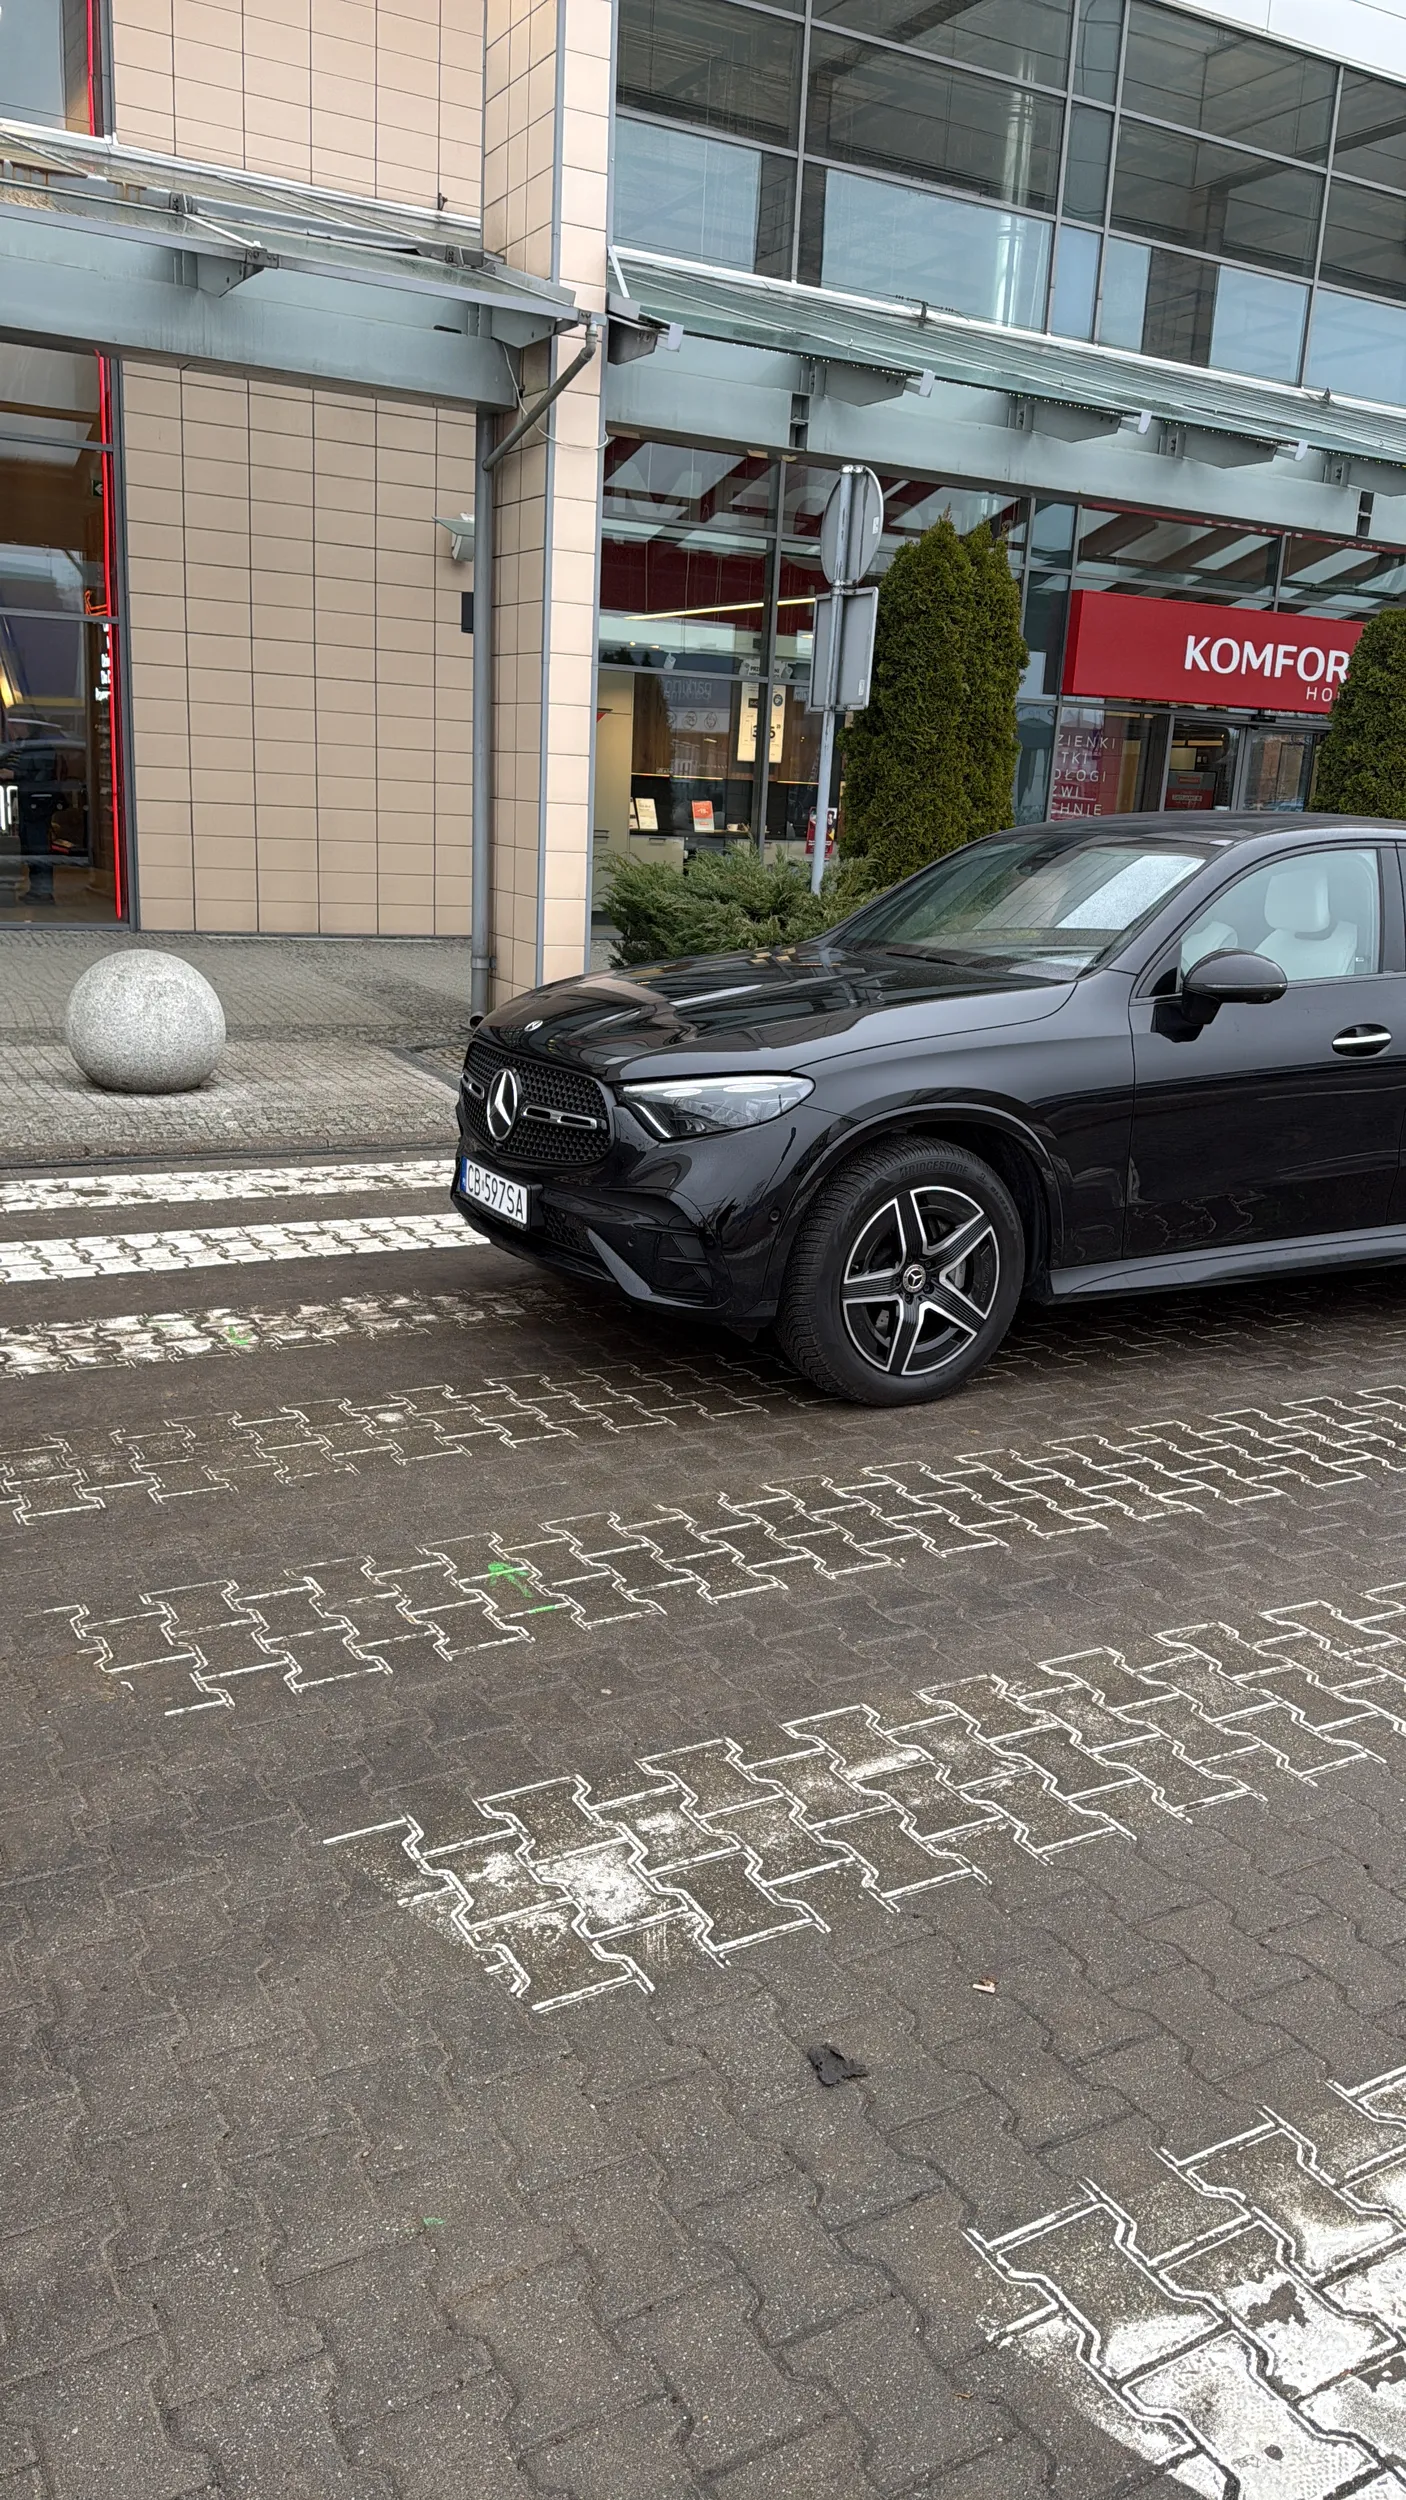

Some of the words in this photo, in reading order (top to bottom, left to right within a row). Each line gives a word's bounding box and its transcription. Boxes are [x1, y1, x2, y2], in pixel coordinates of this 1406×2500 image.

[1184, 635, 1350, 683] KOMFOR
[1305, 686, 1341, 702] HO
[1057, 735, 1116, 750] ZIENKI
[1061, 752, 1088, 764] TKI
[899, 1160, 969, 1178] BRIDGESTONE
[467, 1164, 481, 1197] CB
[484, 1173, 524, 1221] 597SA
